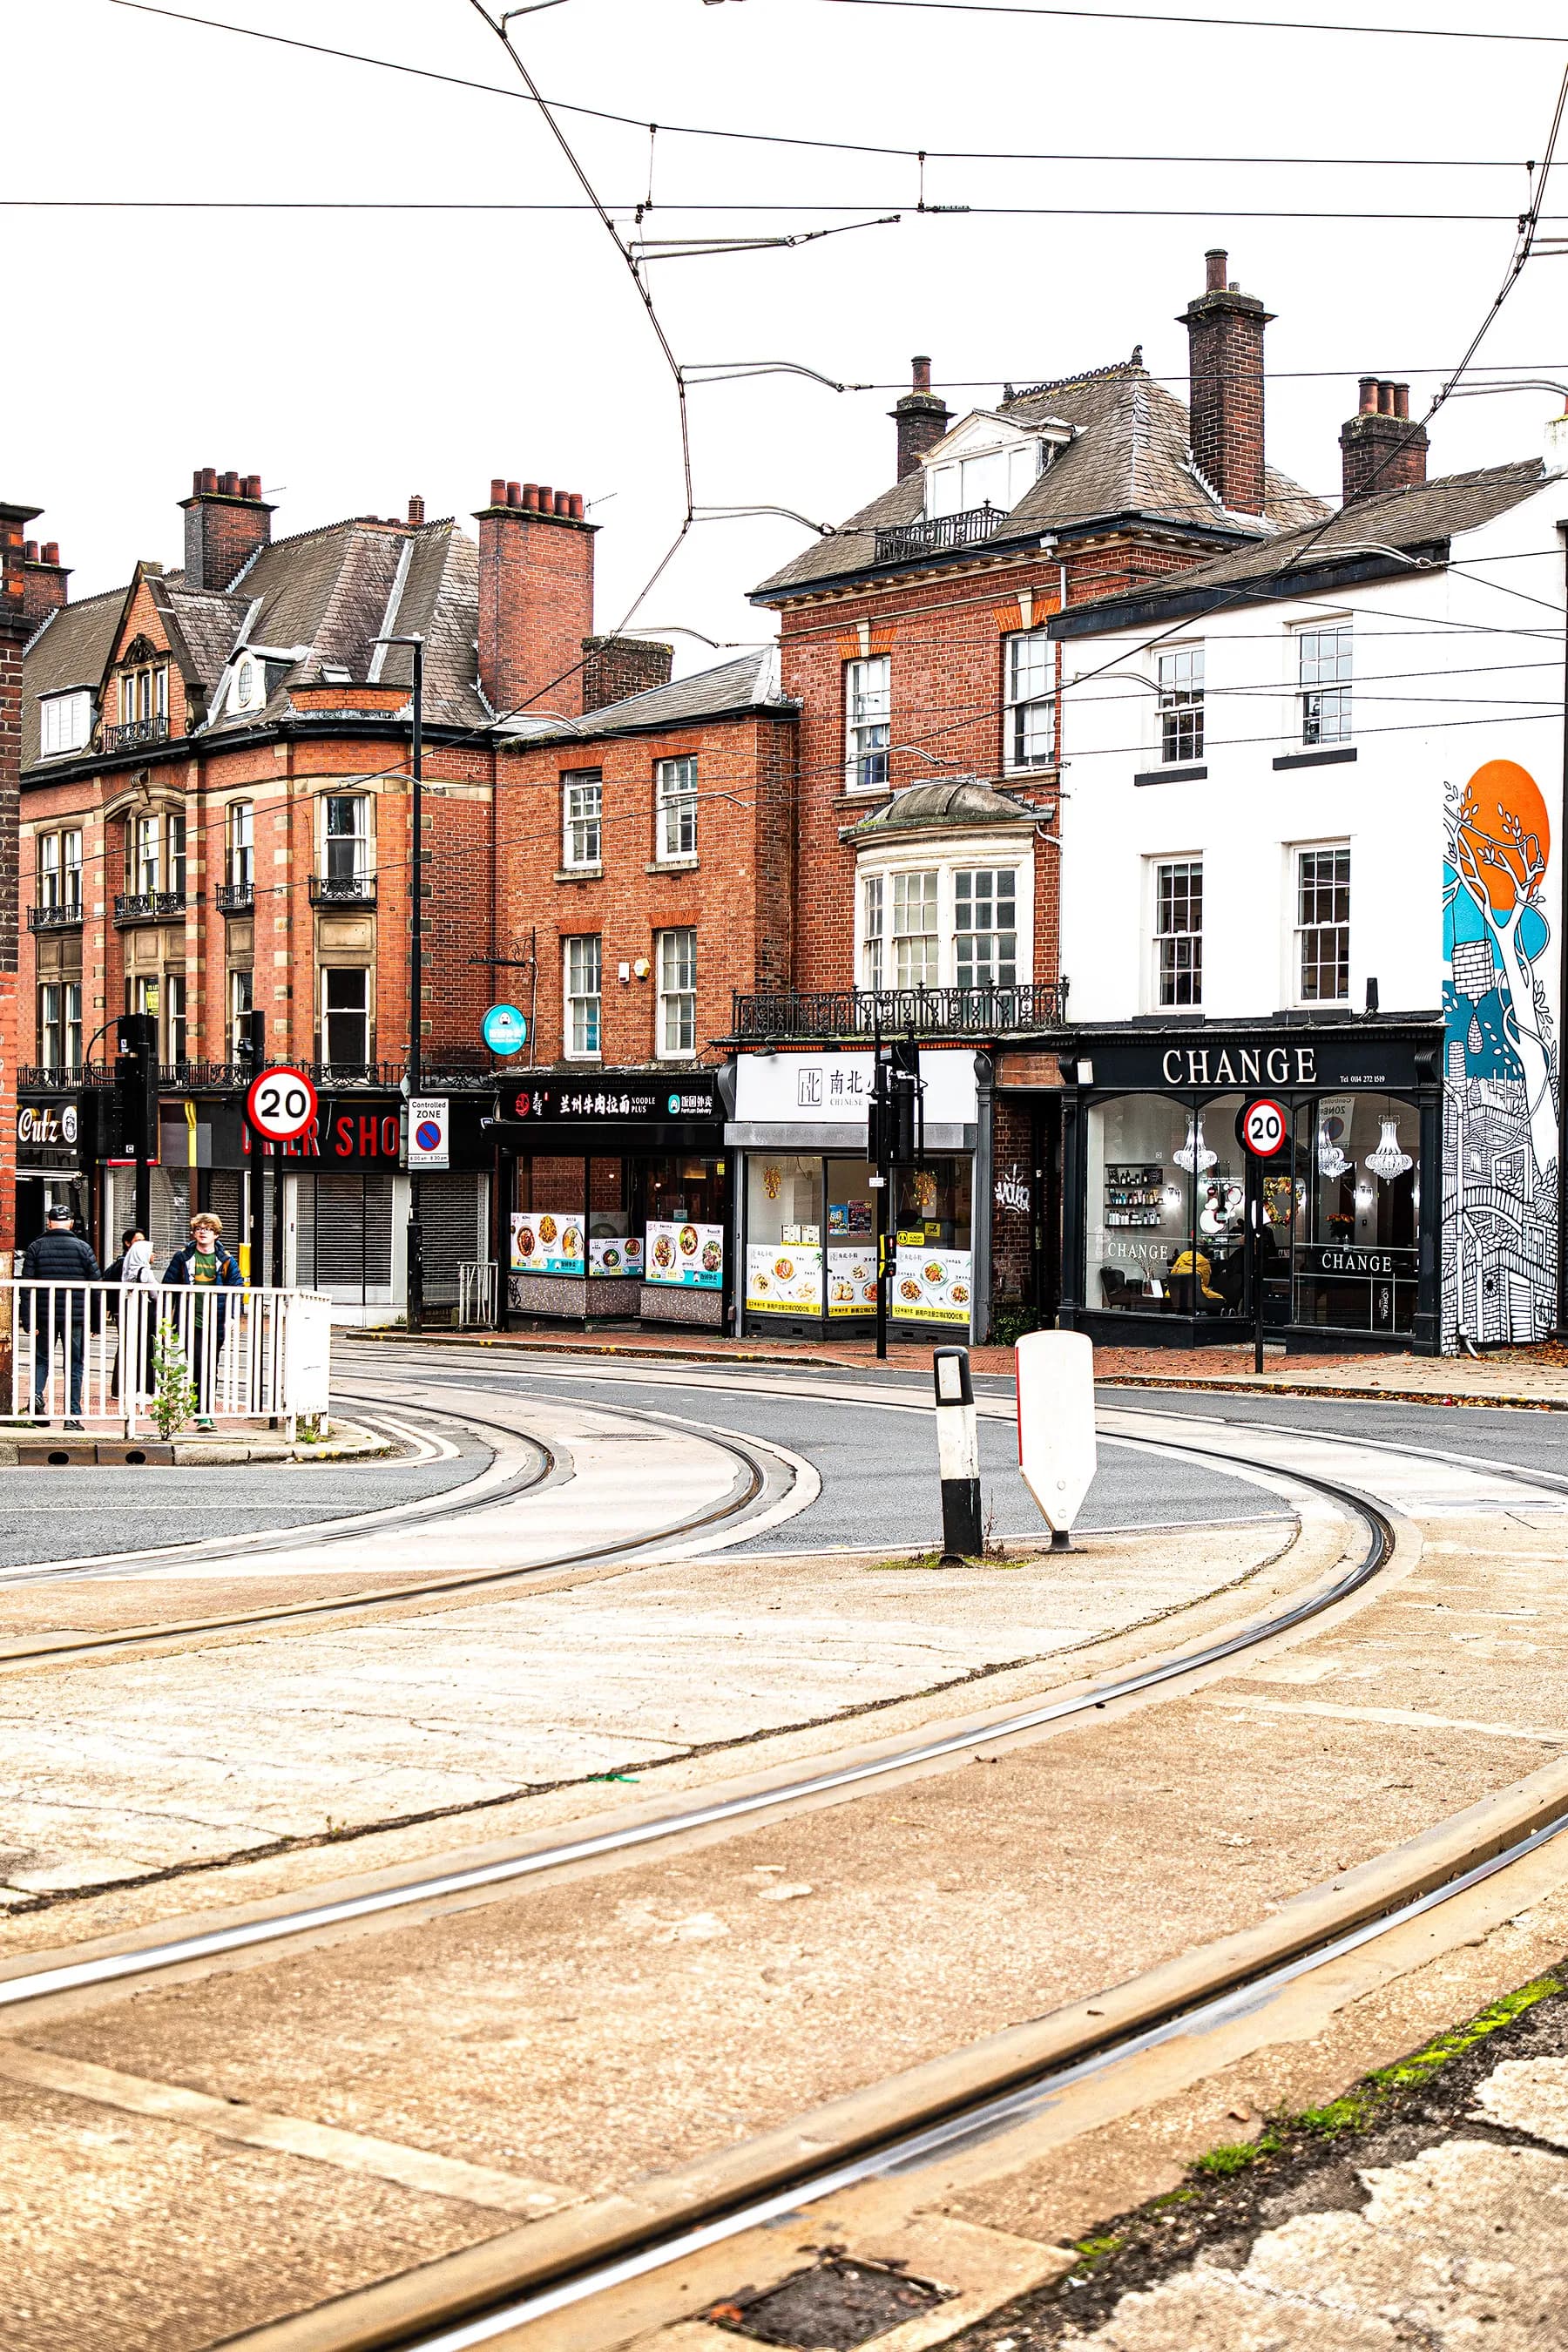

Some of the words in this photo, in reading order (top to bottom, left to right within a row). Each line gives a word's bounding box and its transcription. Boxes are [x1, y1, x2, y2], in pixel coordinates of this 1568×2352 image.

[1162, 1048, 1317, 1085] CHANGE
[261, 1089, 307, 1118] 20
[559, 1093, 630, 1115] 兰州牛肉拉面
[680, 1095, 713, 1108] 饭团外卖
[18, 1108, 59, 1143] Cutz
[416, 1110, 442, 1119] ZONE
[335, 1116, 400, 1156] SHO
[1251, 1117, 1280, 1139] 20
[1108, 1243, 1168, 1260] CHANGE
[1321, 1253, 1392, 1273] CHANGE
